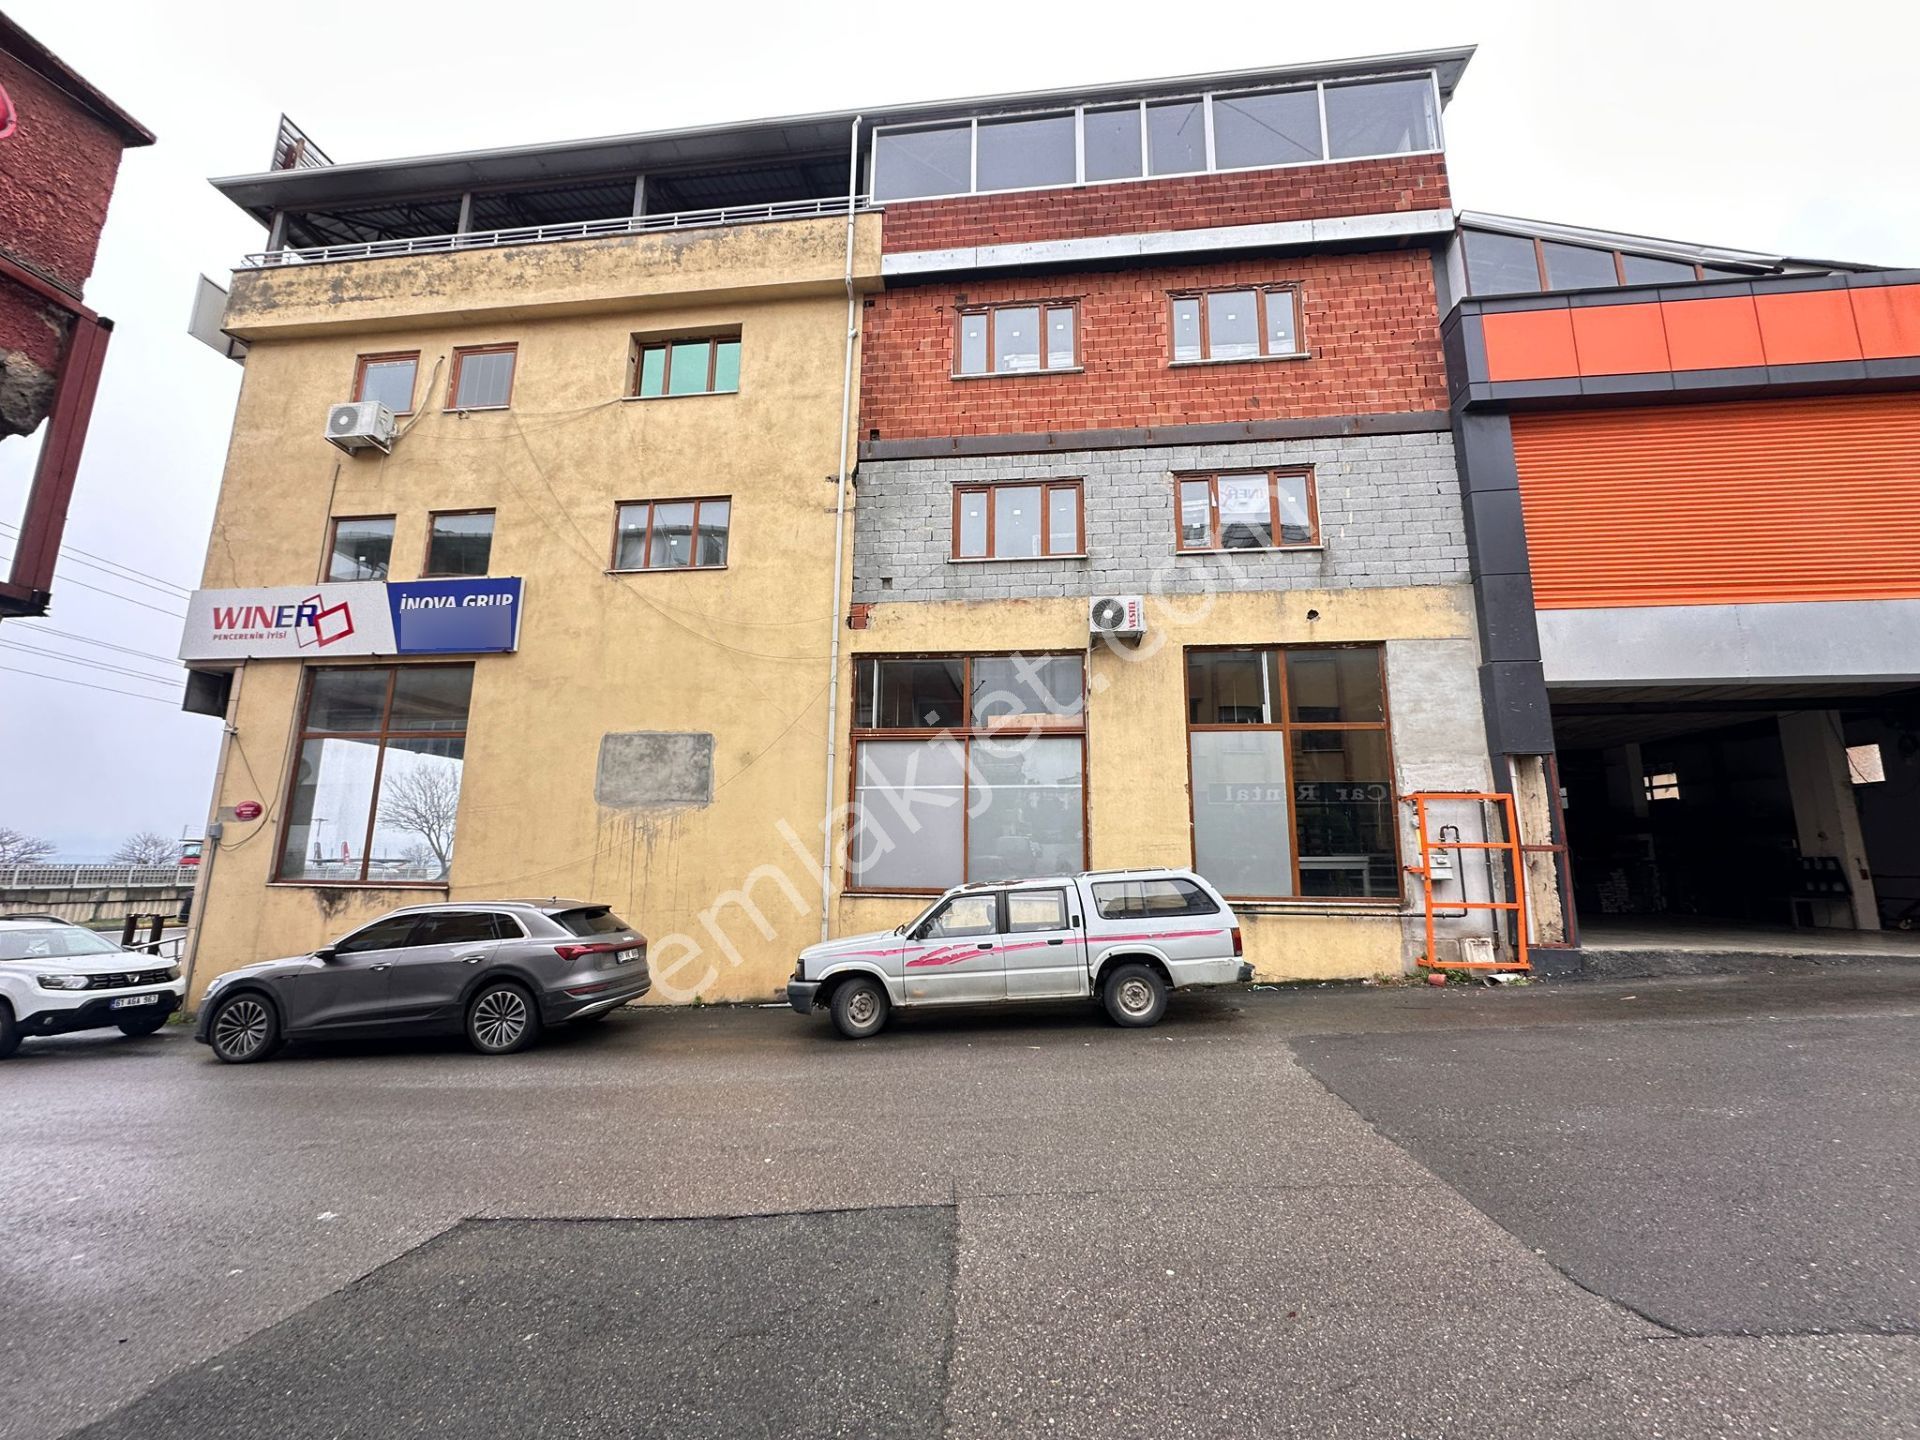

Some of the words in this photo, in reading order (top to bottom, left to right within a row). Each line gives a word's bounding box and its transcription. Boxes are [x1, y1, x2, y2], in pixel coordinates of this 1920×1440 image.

[400, 593, 457, 611] İNOVA
[461, 594, 514, 608] GRUP
[1128, 601, 1137, 629] VESTEL
[213, 604, 318, 630] WINER
